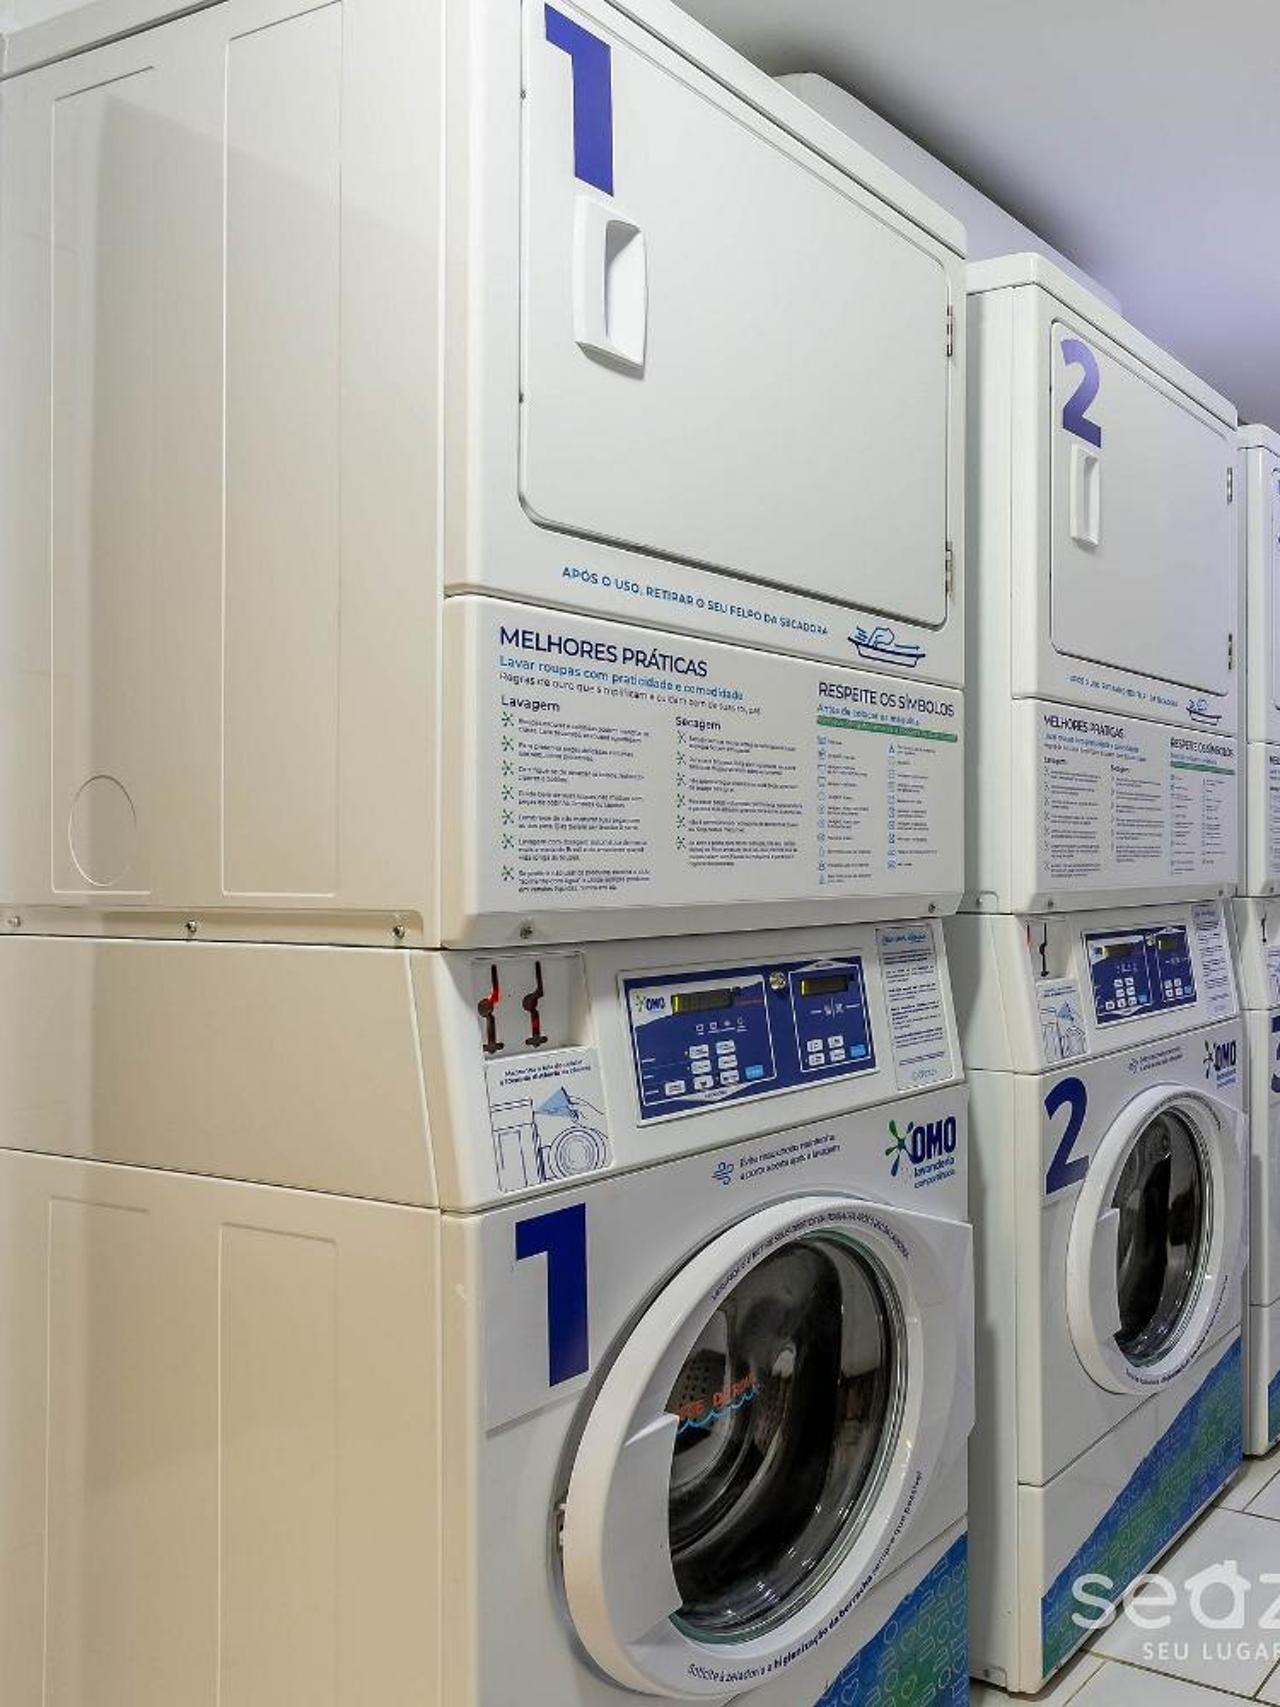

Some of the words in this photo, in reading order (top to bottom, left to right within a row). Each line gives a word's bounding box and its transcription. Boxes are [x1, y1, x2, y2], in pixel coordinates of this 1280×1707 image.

[544, 2, 614, 197] 1
[1060, 338, 1102, 449] 2
[562, 566, 599, 586] APÓS
[602, 576, 611, 587] O
[646, 586, 694, 607] RETIRAR
[697, 598, 705, 609] O
[707, 600, 729, 614] SEU
[780, 615, 829, 636] SECADORA
[500, 626, 619, 663] MELHORES
[622, 647, 709, 678] PRÁTICAS
[500, 655, 535, 671] Lavar
[538, 662, 581, 678] roupas
[583, 670, 609, 681] com
[612, 672, 674, 693] praticidade
[675, 684, 682, 692] e
[684, 684, 744, 701] comodidade
[500, 671, 535, 688] Regras
[818, 682, 878, 706] RESPEITE
[879, 692, 897, 707] OS
[898, 692, 955, 718] SÍMBOLOS
[501, 695, 561, 712] Lavagem
[675, 716, 722, 731] Secagem
[646, 995, 665, 1010] OMO
[910, 1115, 957, 1164] OMO
[1044, 1076, 1091, 1194] 2
[913, 1157, 955, 1179] lavanderia
[514, 1202, 590, 1388] 1
[773, 1627, 829, 1669] higienização
[829, 1615, 839, 1630] da
[838, 1574, 873, 1619] borracha
[894, 1515, 906, 1537] que
